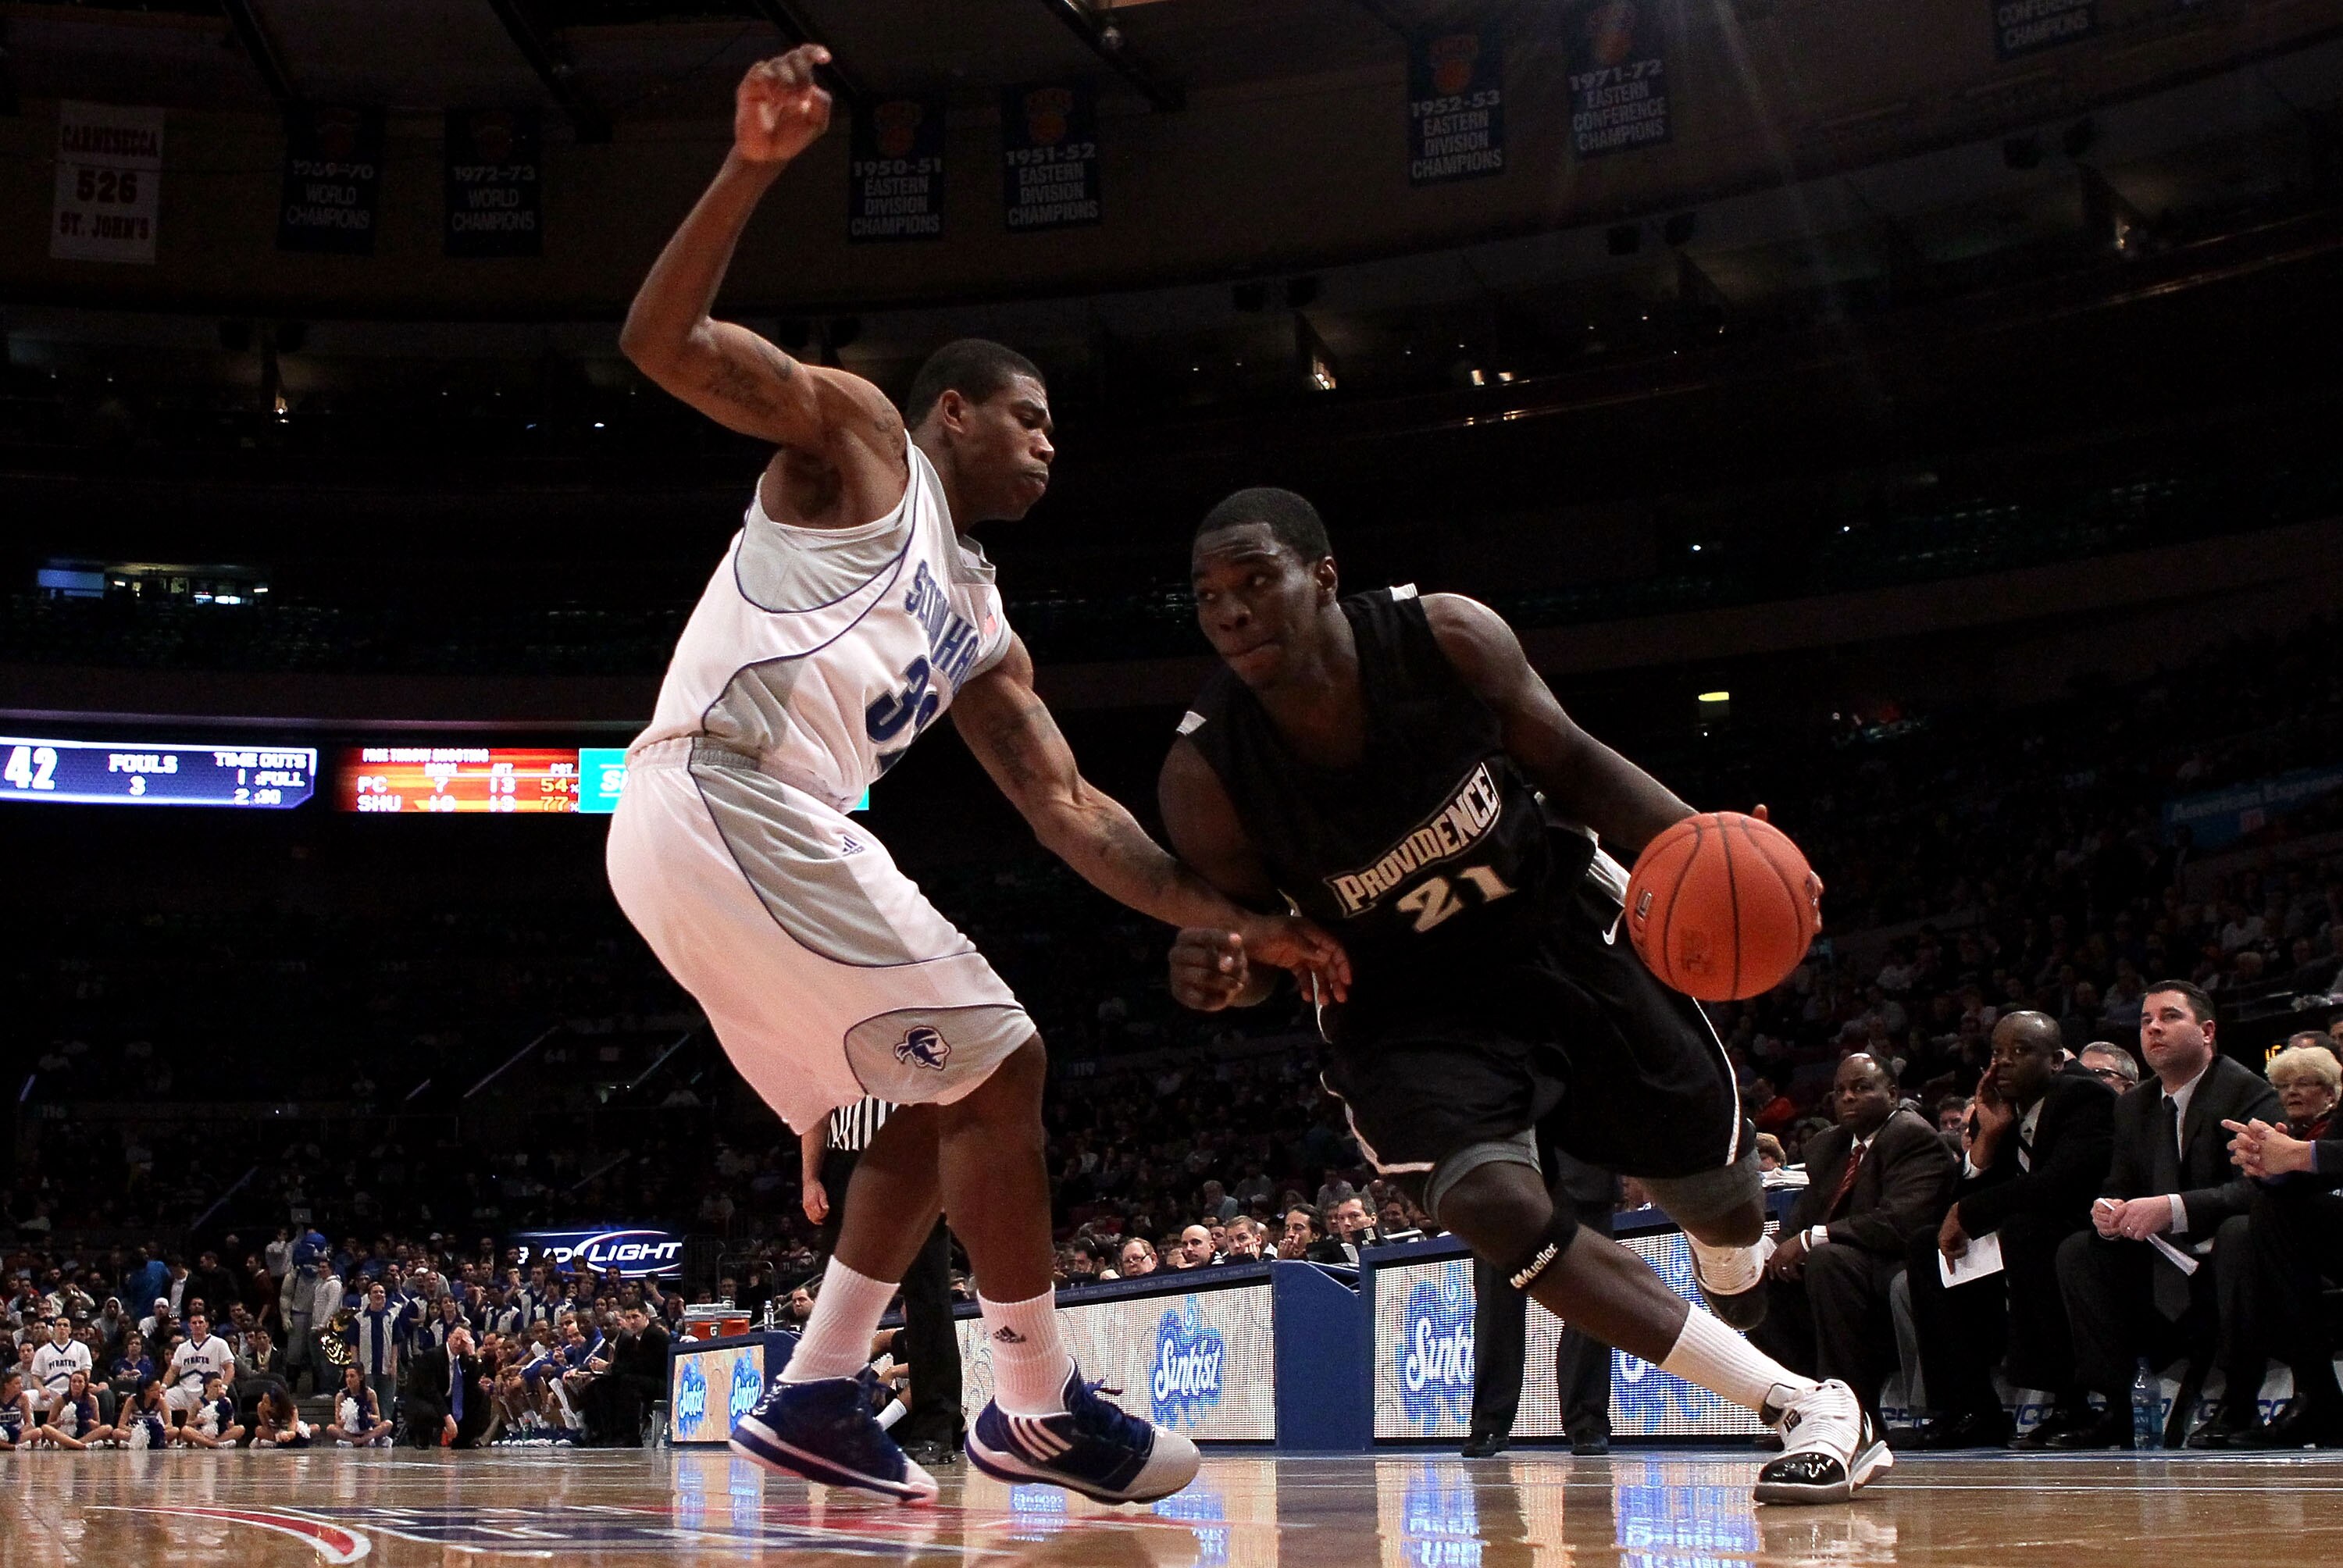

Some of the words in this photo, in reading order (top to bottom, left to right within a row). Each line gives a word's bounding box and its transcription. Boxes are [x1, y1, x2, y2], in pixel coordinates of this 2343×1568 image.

[1410, 89, 1501, 117] 1952-53
[1586, 80, 1649, 109] EASTERN
[1423, 109, 1489, 137] EASTERN
[1572, 96, 1667, 133] CONFERENCE
[1424, 130, 1489, 156] DIVISION
[1578, 118, 1666, 151] CHAMPIONS
[1004, 142, 1097, 166] 1951-52
[1411, 148, 1503, 180] CHAMPIONS
[452, 165, 537, 183] 1972-73
[852, 157, 942, 177] 1950-51
[1019, 162, 1085, 186] EASTERN
[77, 169, 138, 205] 526
[305, 184, 357, 206] WORLD
[864, 176, 929, 196] EASTERN
[1019, 182, 1085, 205] DIVISION
[468, 189, 519, 208] WORLD
[864, 195, 928, 216] DIVISION
[61, 211, 87, 237] ST.
[91, 215, 148, 240] JOHN'S
[285, 205, 370, 230] CHAMPIONS
[452, 211, 536, 233] CHAMPIONS
[851, 214, 941, 236] CHAMPIONS
[1007, 201, 1099, 227] CHAMPIONS
[4, 746, 58, 790] 42
[108, 754, 178, 774] FOULS
[213, 752, 259, 768] TIME
[259, 753, 307, 769] OUTS
[128, 775, 147, 796] 3
[237, 768, 246, 786] 1
[357, 775, 387, 793] PC
[433, 776, 450, 793] 7
[489, 776, 517, 794] 13
[234, 788, 250, 805] 2
[357, 795, 401, 812] SHU
[429, 795, 456, 812] 10
[489, 795, 517, 813] 13
[1331, 765, 1499, 912] PROVIDENCE
[1394, 864, 1517, 935] 21
[590, 1242, 683, 1262] LIGHT
[48, 1360, 77, 1370] PIRATES
[184, 1356, 210, 1367] PIRATES
[1405, 1317, 1475, 1392] Sunk
[1154, 1338, 1222, 1401] Sunkist
